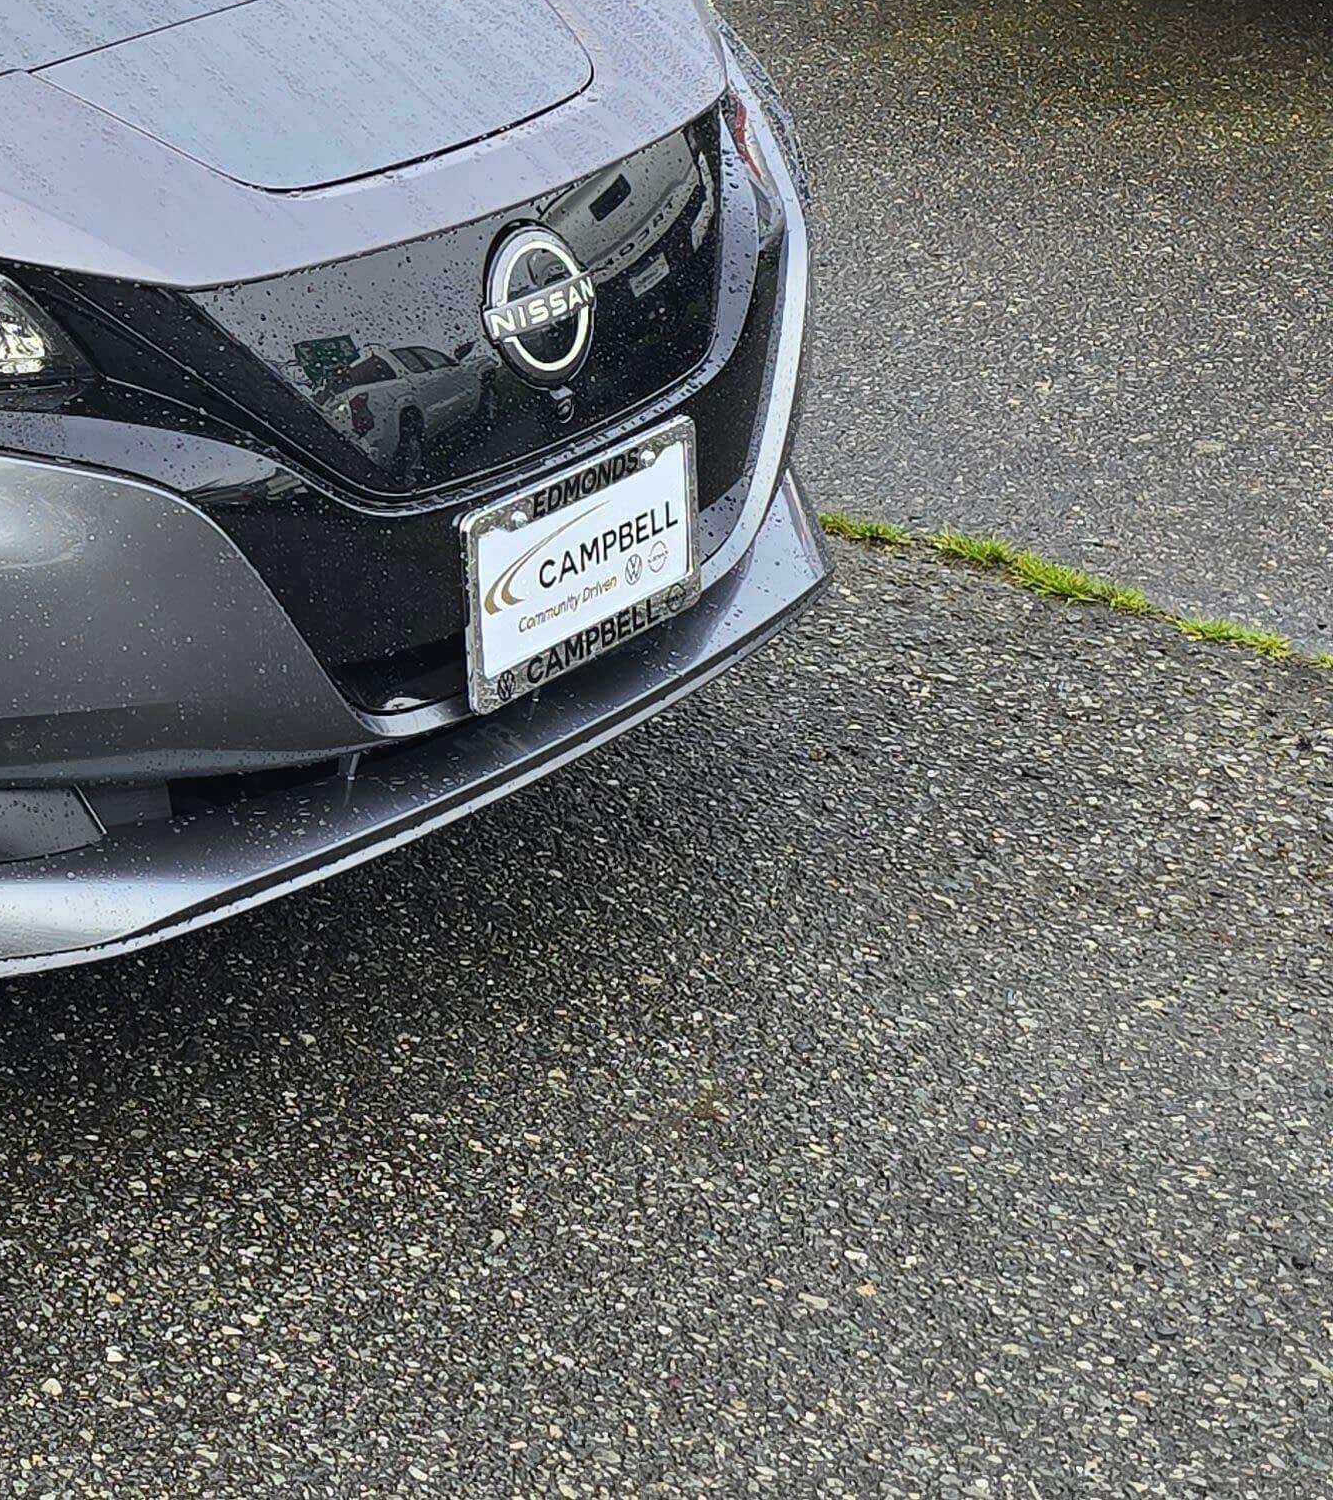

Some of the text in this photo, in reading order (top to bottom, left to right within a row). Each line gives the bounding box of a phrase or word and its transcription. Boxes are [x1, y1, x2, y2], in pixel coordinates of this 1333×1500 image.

[490, 276, 594, 337] NISSAN
[533, 447, 639, 518] EDMONDS
[538, 500, 678, 588] CAMPBELL
[518, 576, 617, 633] Community Driven
[527, 598, 661, 684] CAMPBELL
